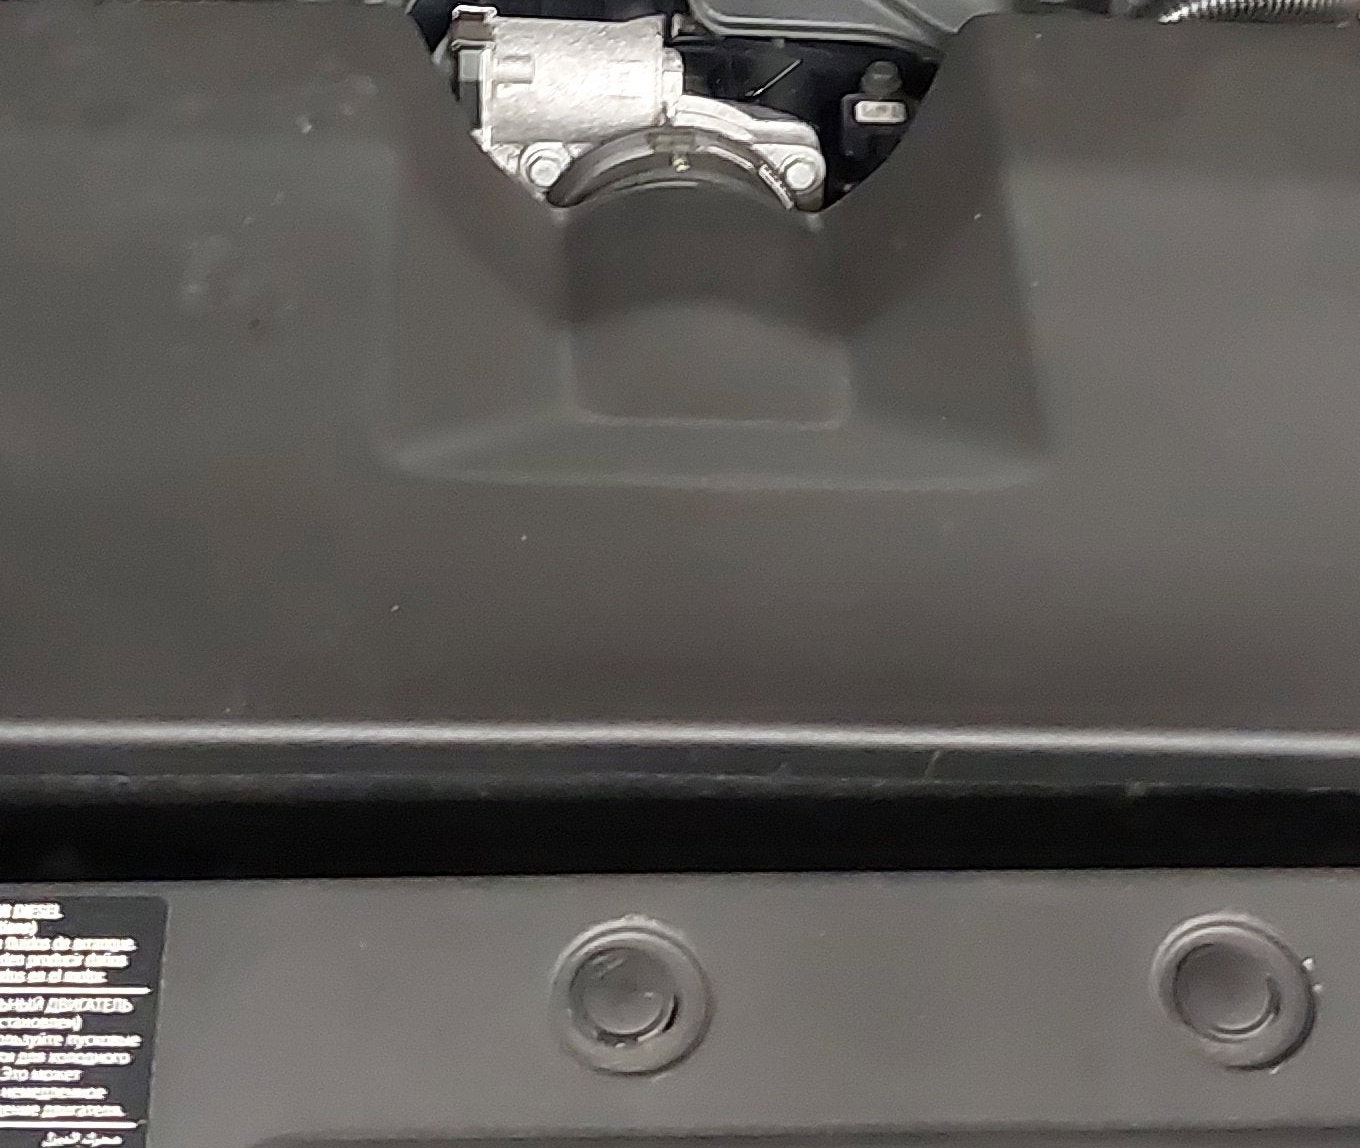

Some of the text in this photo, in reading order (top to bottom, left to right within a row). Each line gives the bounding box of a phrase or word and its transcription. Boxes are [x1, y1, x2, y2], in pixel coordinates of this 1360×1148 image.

[12, 903, 64, 919] DIESEL
[4, 937, 51, 950] fluidos
[52, 936, 71, 950] de
[25, 953, 84, 969] producir
[27, 971, 46, 982] en
[47, 969, 62, 982] el
[44, 997, 134, 1013] ДВИГАТЕЛЬ
[15, 1052, 46, 1065] для
